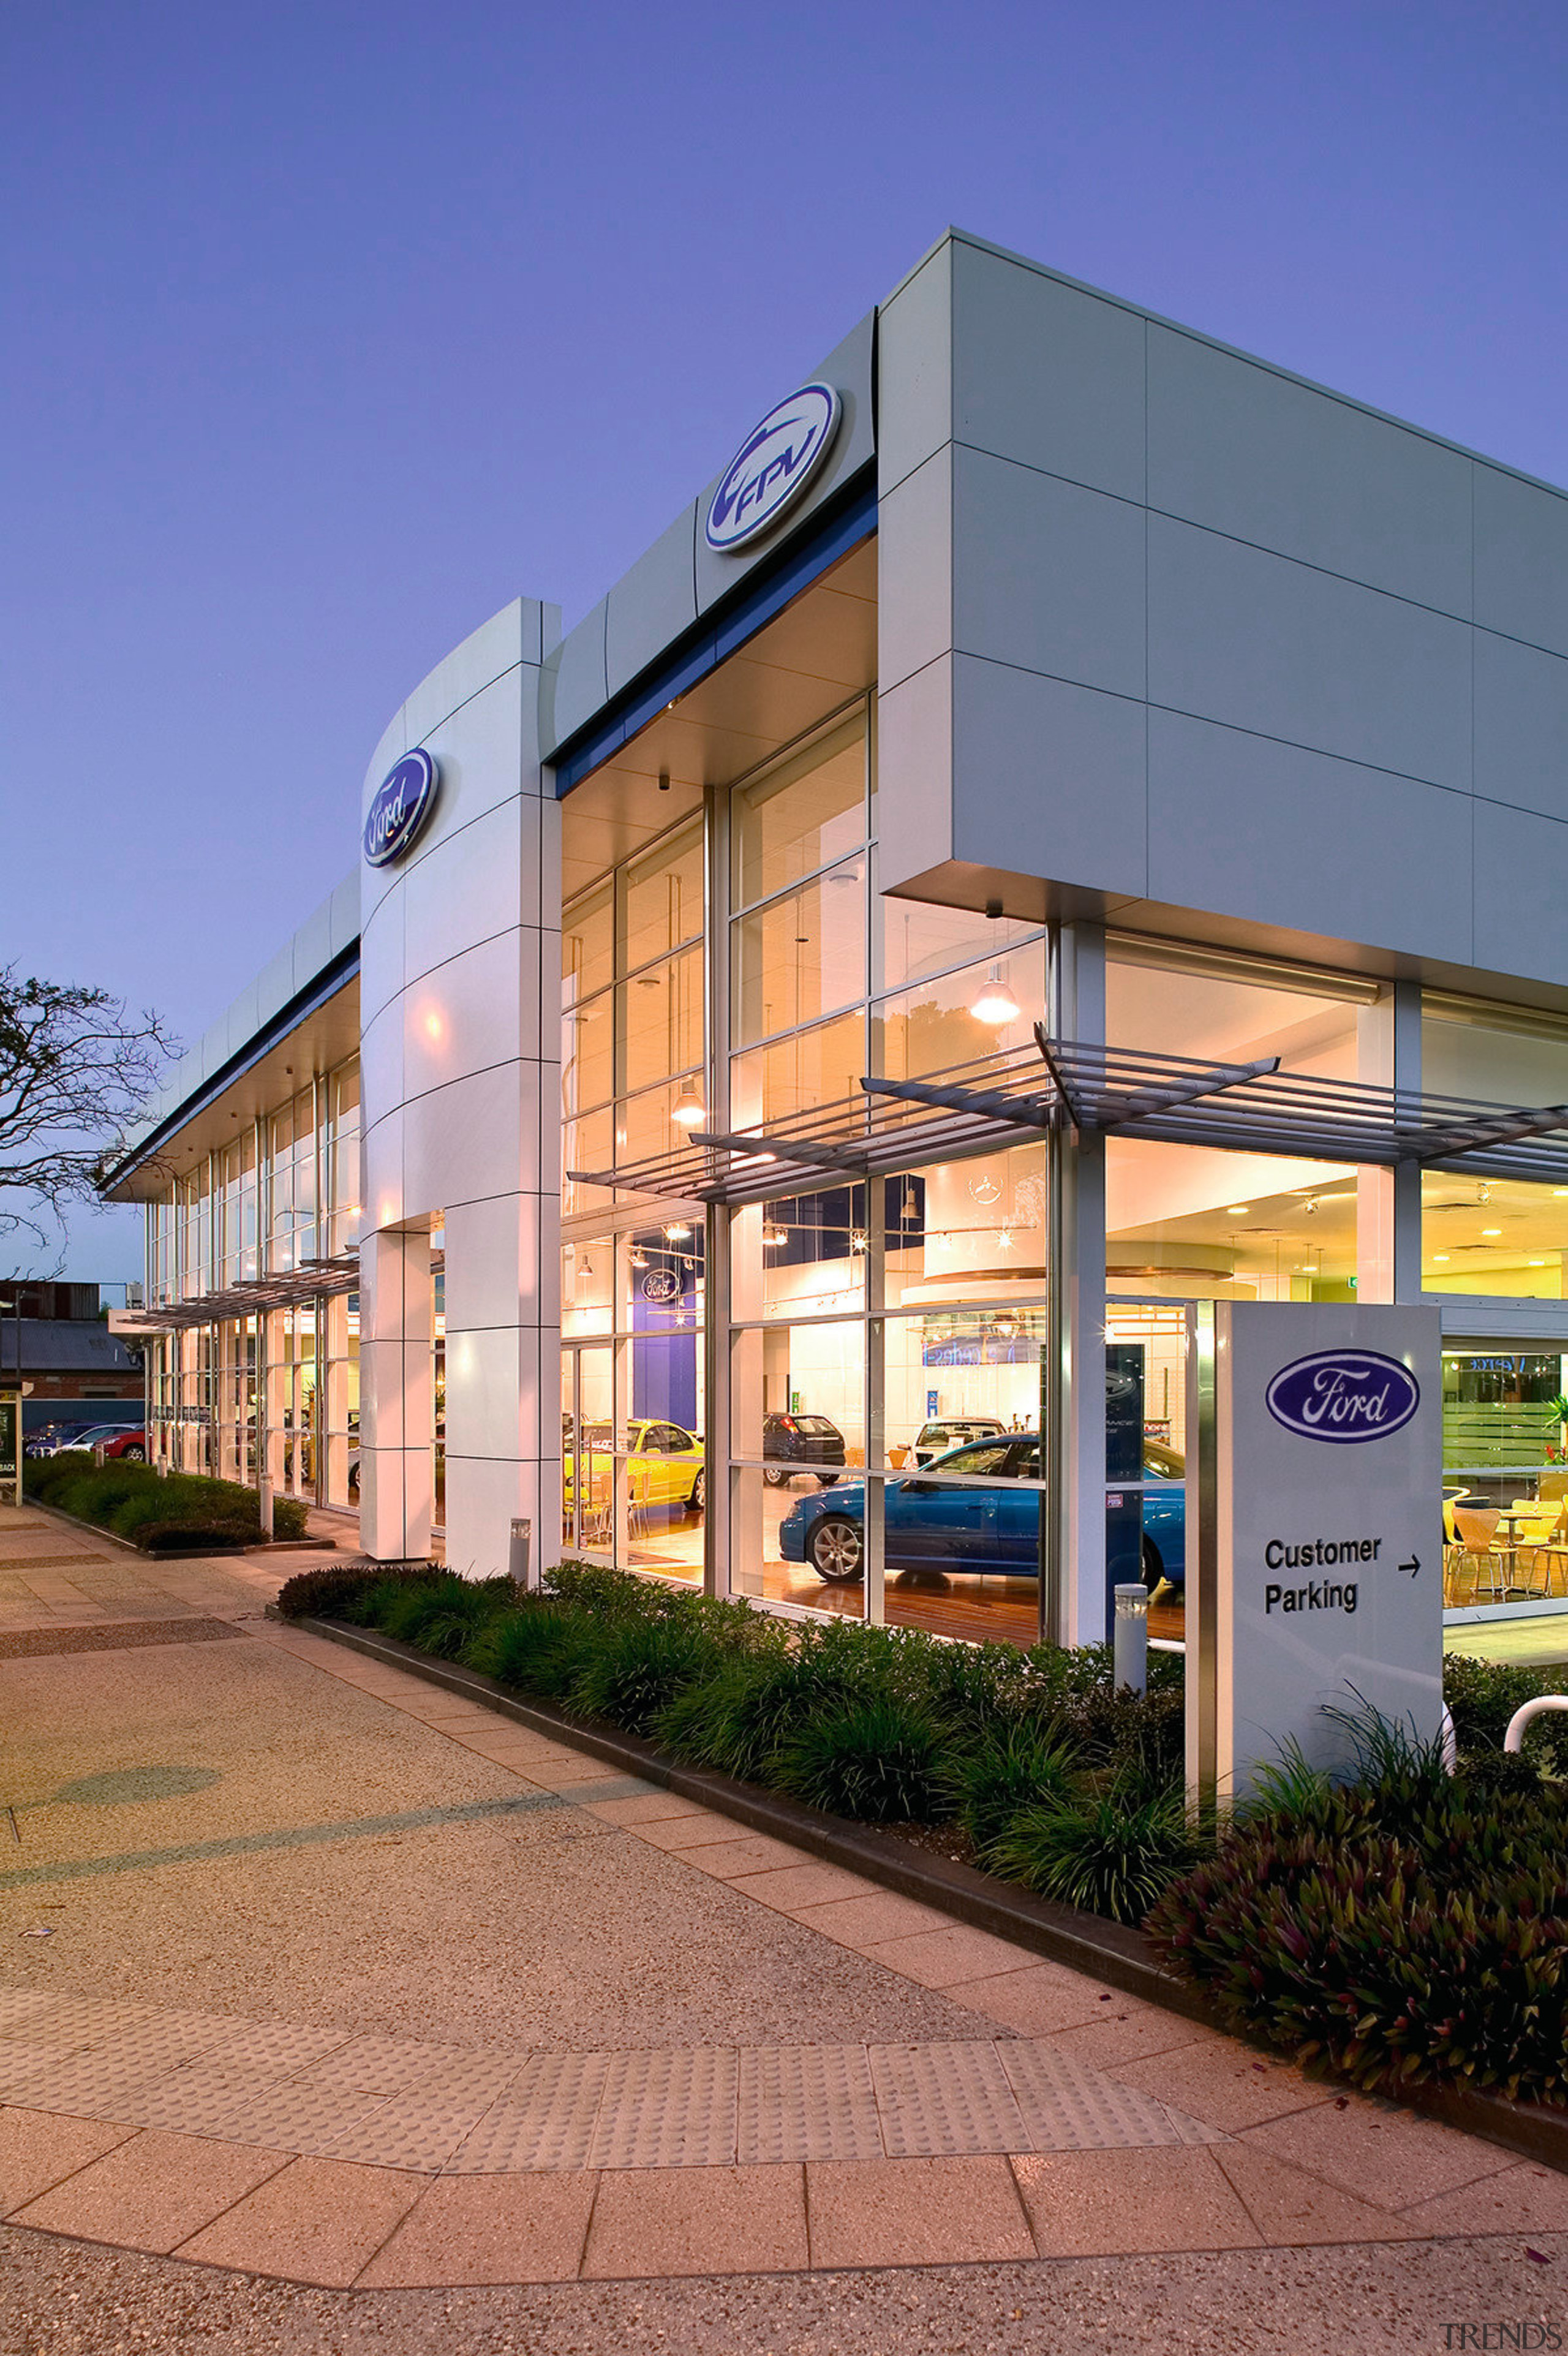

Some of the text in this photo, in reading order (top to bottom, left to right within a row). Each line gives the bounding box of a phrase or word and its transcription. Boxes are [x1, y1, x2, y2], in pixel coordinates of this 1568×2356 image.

[734, 424, 818, 526] FPV
[369, 776, 407, 854] Ford
[646, 1274, 671, 1296] Ford
[1302, 1367, 1391, 1424] Ford
[1265, 1538, 1382, 1569] Customer
[1265, 1579, 1359, 1614] Parking
